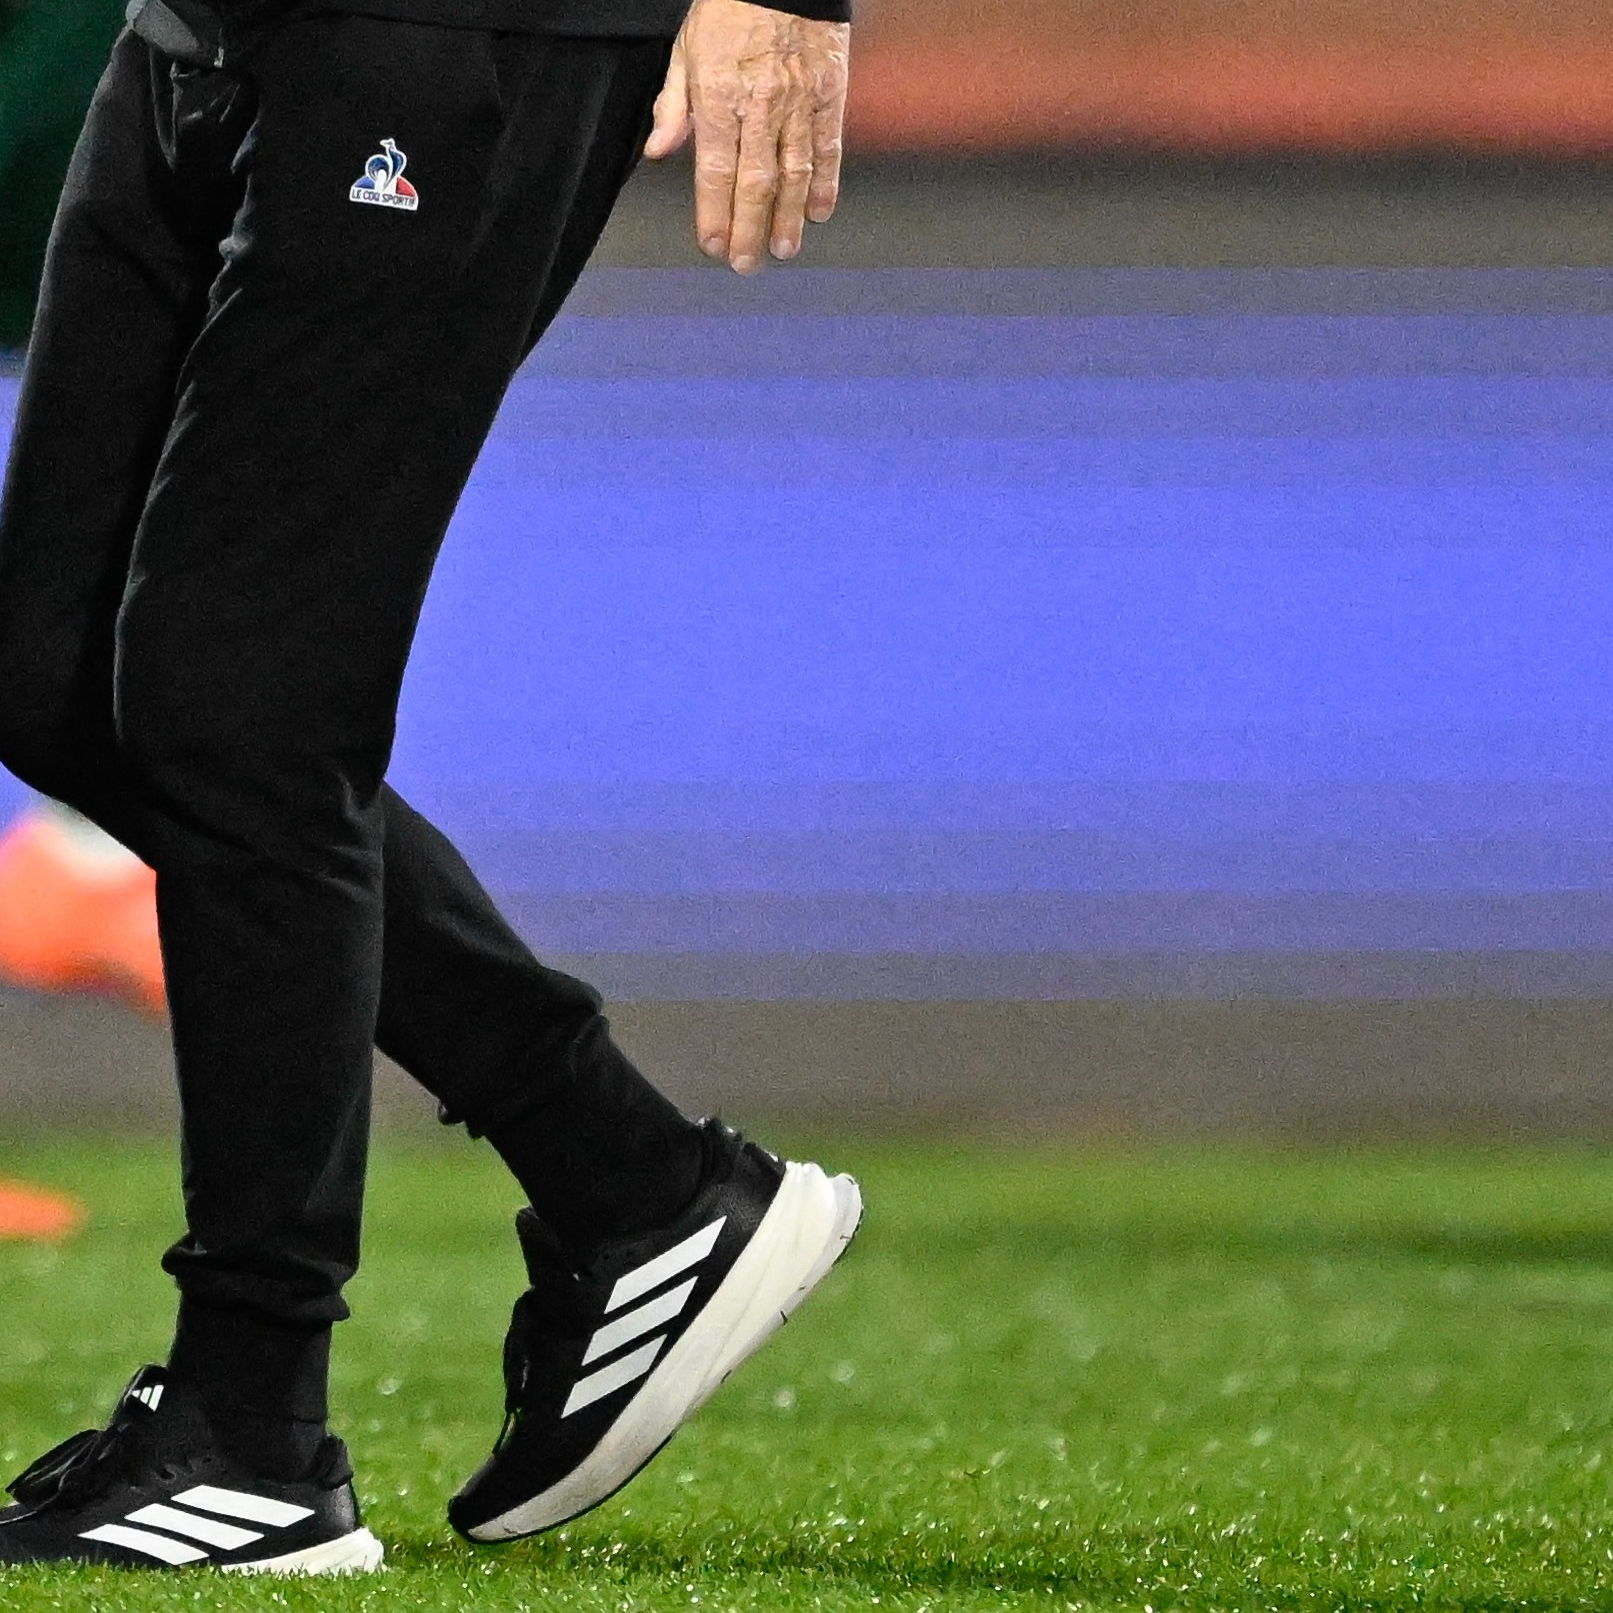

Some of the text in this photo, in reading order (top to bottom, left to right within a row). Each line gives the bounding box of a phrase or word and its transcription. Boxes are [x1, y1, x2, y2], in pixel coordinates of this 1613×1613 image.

[352, 189, 415, 207] LE COQ SPORTIF
